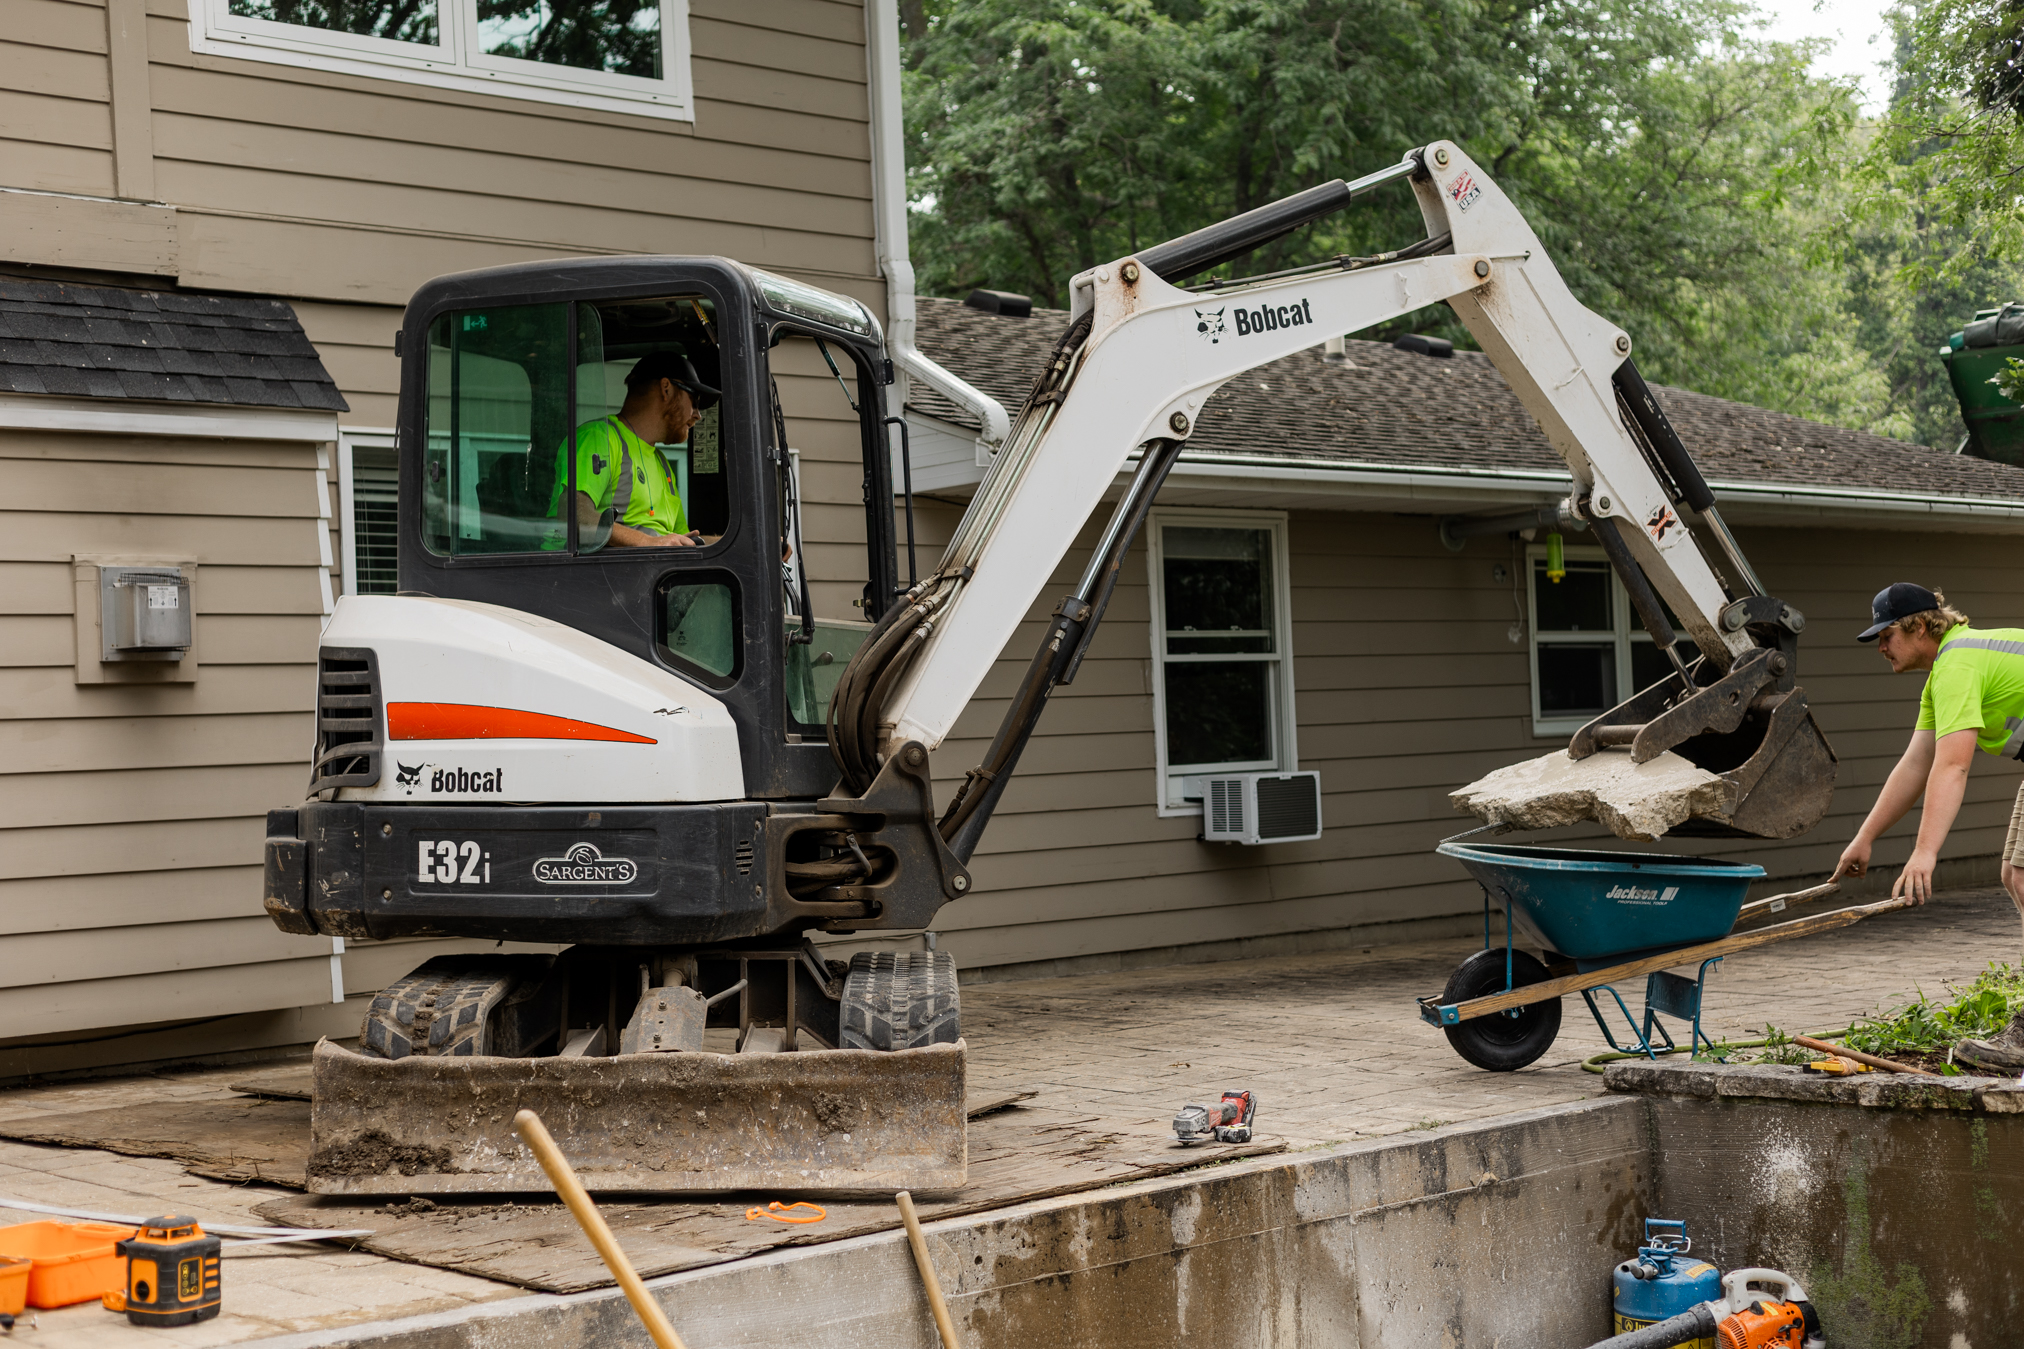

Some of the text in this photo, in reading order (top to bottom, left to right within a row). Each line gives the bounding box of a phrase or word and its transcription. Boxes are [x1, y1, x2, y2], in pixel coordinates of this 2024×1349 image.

[1459, 188, 1480, 209] USA
[1233, 297, 1313, 336] Bobcat
[430, 767, 503, 793] Bobcat
[418, 840, 491, 884] E32i
[539, 863, 630, 880] SARGENT'S
